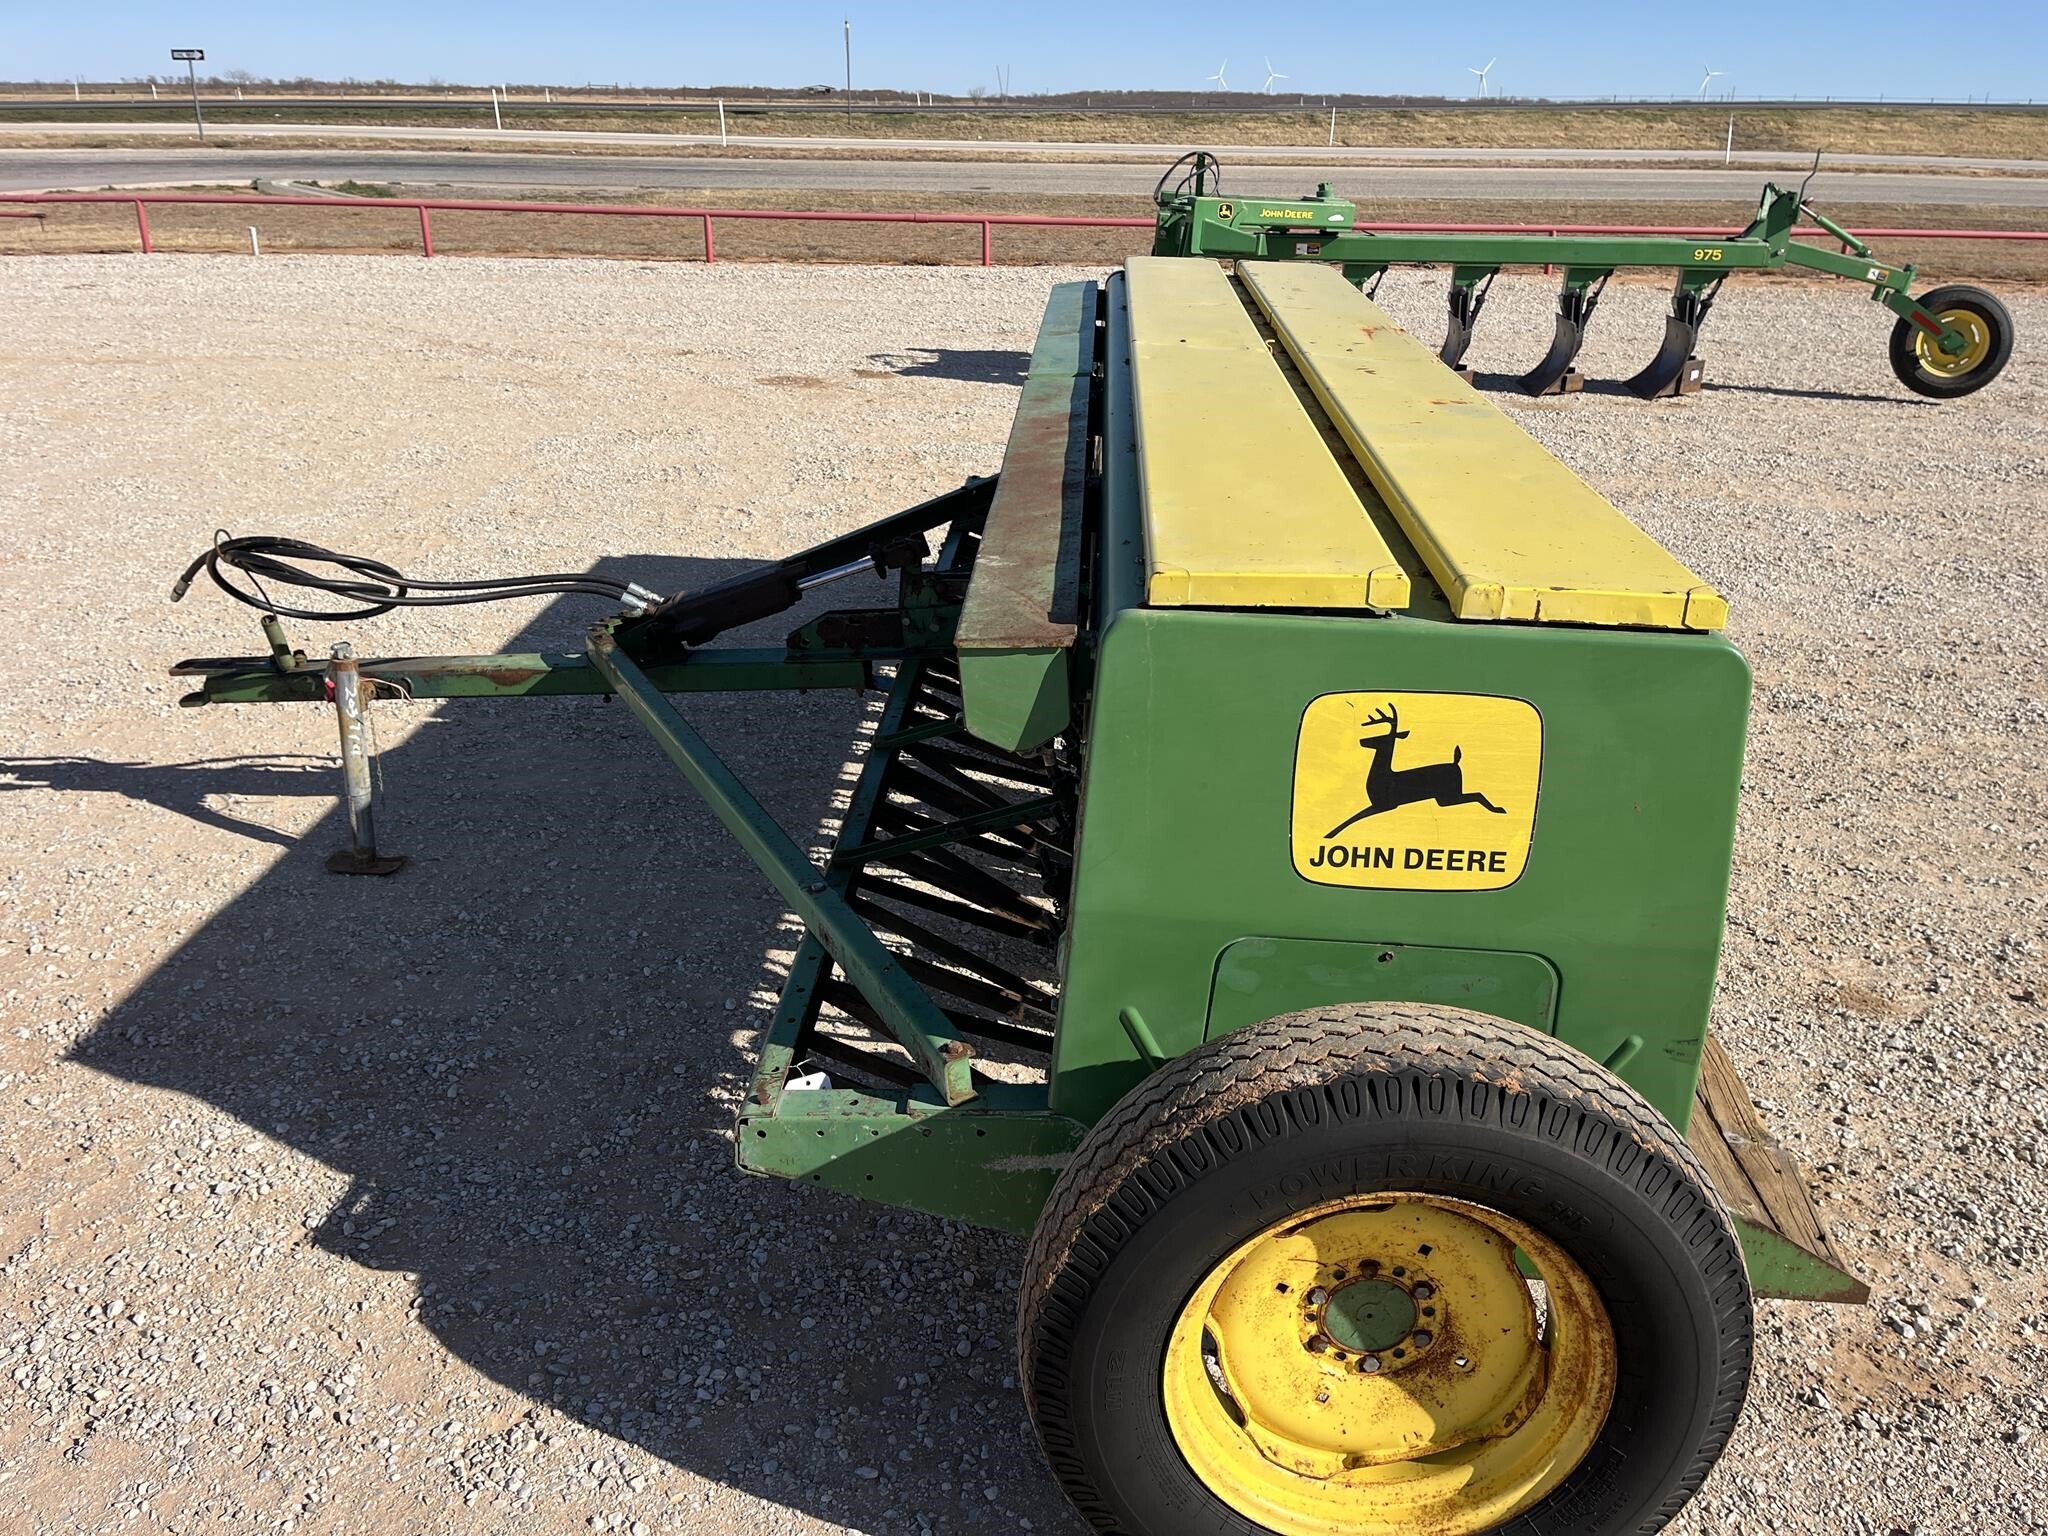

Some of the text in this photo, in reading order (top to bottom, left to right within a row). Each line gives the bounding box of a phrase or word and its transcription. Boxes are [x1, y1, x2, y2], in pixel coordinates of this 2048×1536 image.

[1259, 208, 1314, 219] JOHN DEERE
[1693, 249, 1722, 261] 975
[1309, 845, 1507, 873] JOHN DEERE
